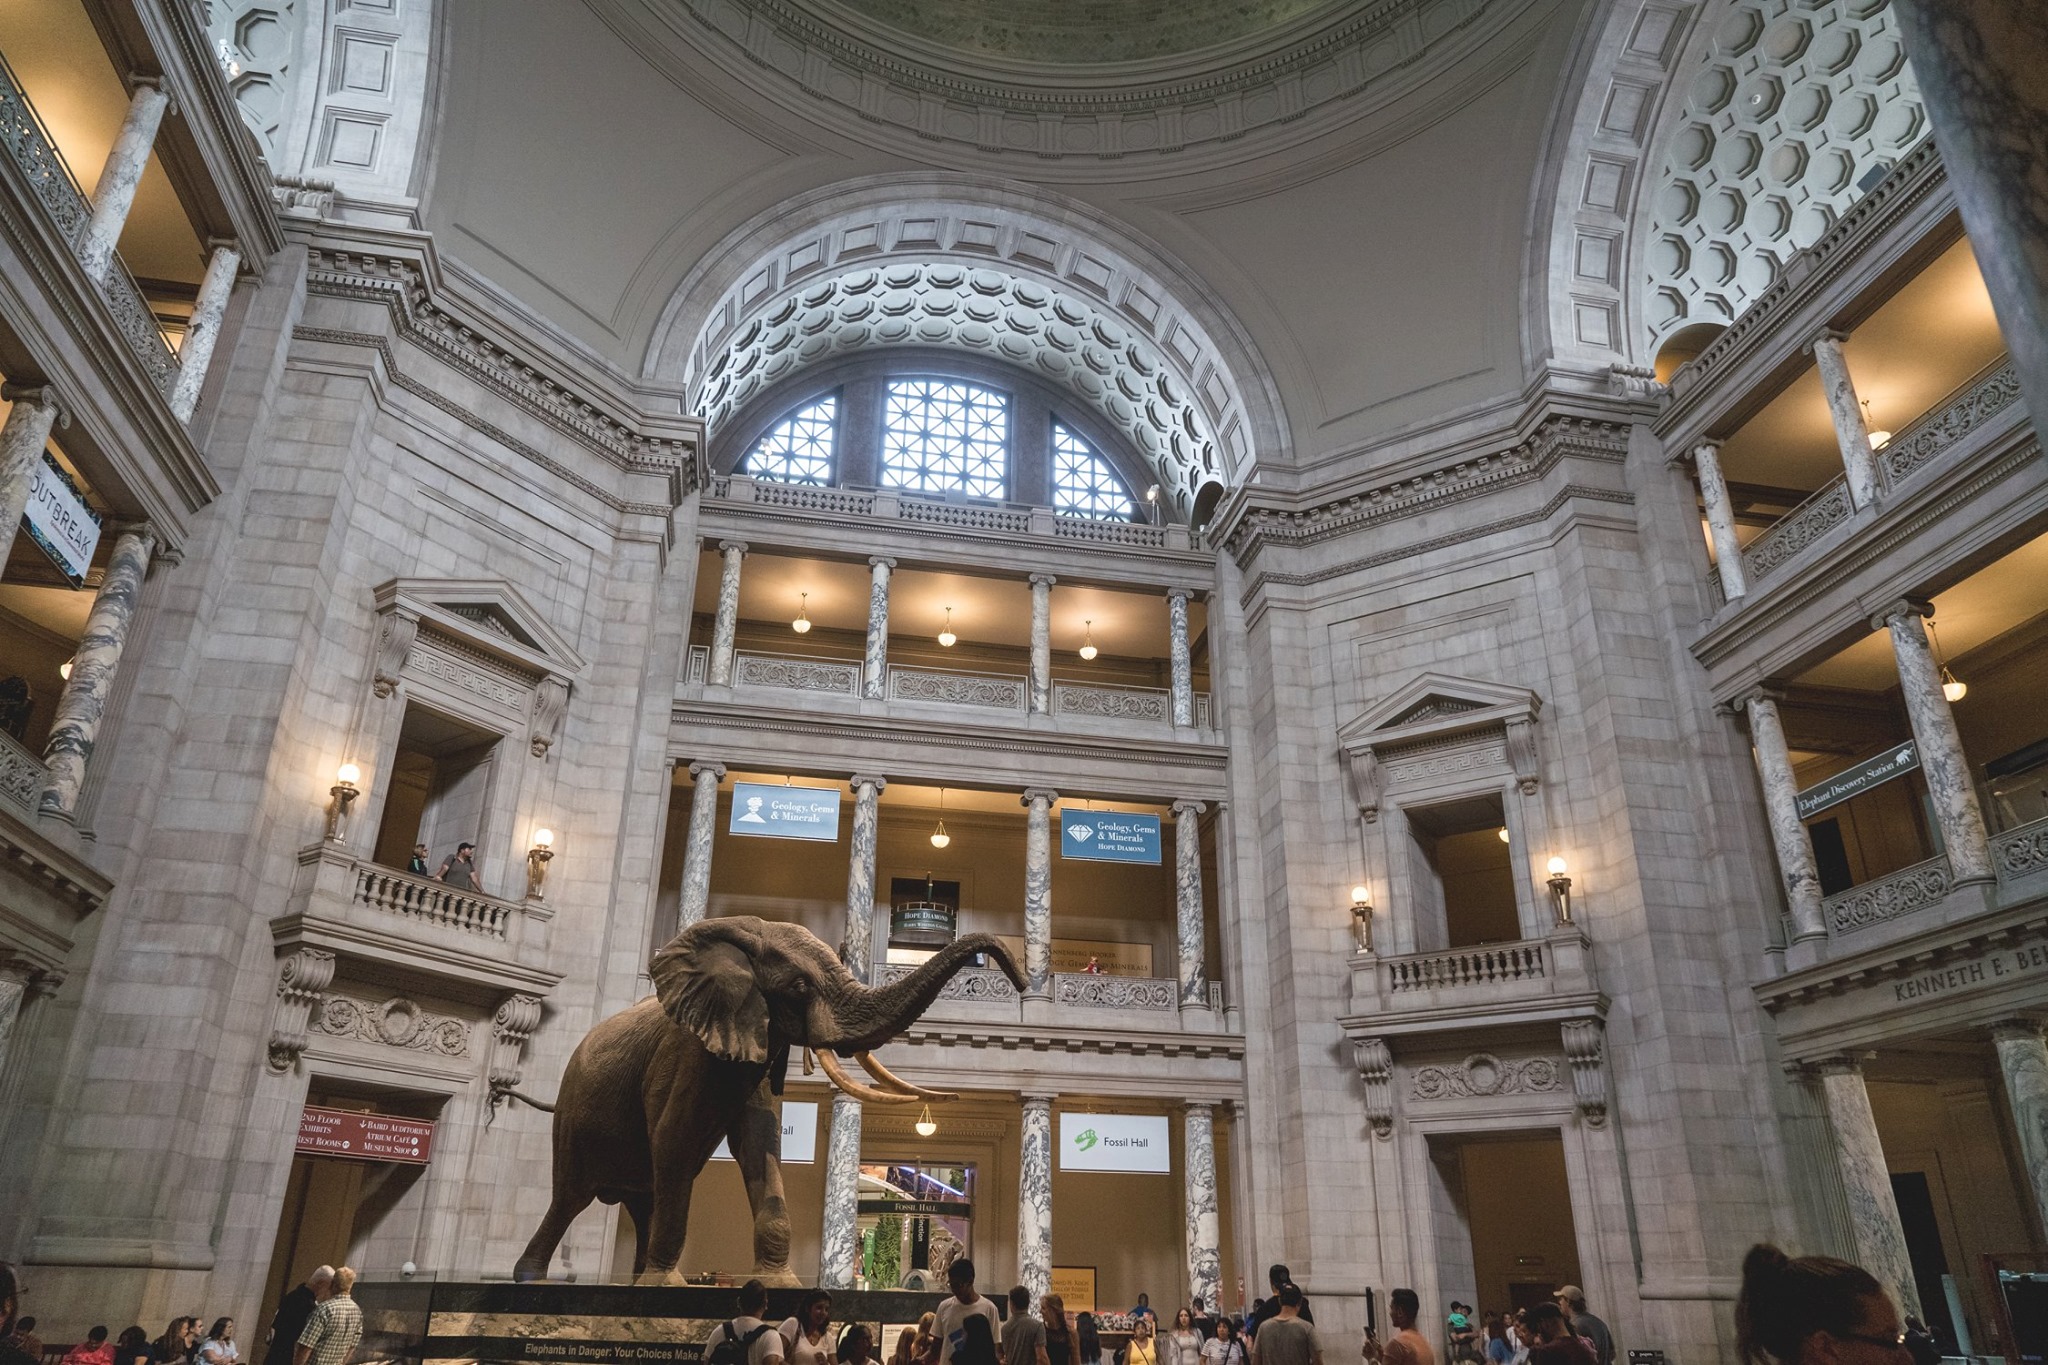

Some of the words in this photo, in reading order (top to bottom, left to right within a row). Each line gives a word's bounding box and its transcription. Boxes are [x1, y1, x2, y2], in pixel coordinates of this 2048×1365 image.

[1800, 791, 1831, 811] Elephant
[1830, 774, 1866, 797] Discovery
[1866, 762, 1895, 780] Station
[771, 800, 808, 813] Geology,
[810, 803, 835, 814] Gems
[770, 811, 780, 820] &
[781, 811, 821, 823] Minerals
[1097, 821, 1132, 834] Geology,
[1133, 824, 1156, 834] Gems
[1097, 831, 1105, 840] &
[1108, 831, 1144, 843] Minerals
[1098, 843, 1116, 851] HOPE
[1117, 844, 1146, 853] DIAMOND
[904, 912, 921, 920] HOPE
[922, 911, 949, 922] DIAMOND
[1110, 962, 1149, 971] MINERALS
[1893, 962, 1986, 1001] KENNETH
[1991, 957, 2010, 977] E.
[317, 1114, 342, 1126] FLOOR
[367, 1120, 389, 1131] BAIRD
[390, 1123, 431, 1136] AUDITORIUM
[781, 1126, 794, 1135] all
[316, 1137, 342, 1148] ROOMS
[365, 1131, 392, 1142] ATRIUM
[1104, 1136, 1128, 1147] Fossil
[1130, 1138, 1149, 1147] Hall
[362, 1141, 392, 1153] MUSEUM
[393, 1145, 411, 1155] SHOP
[895, 1202, 917, 1211] FOSSIL
[919, 1203, 938, 1212] HALL
[525, 1343, 566, 1356] Elephants
[568, 1344, 576, 1355] in
[578, 1344, 613, 1360] Danger:
[614, 1346, 635, 1358] Your
[636, 1347, 673, 1360] Choices
[674, 1348, 699, 1361] Make
